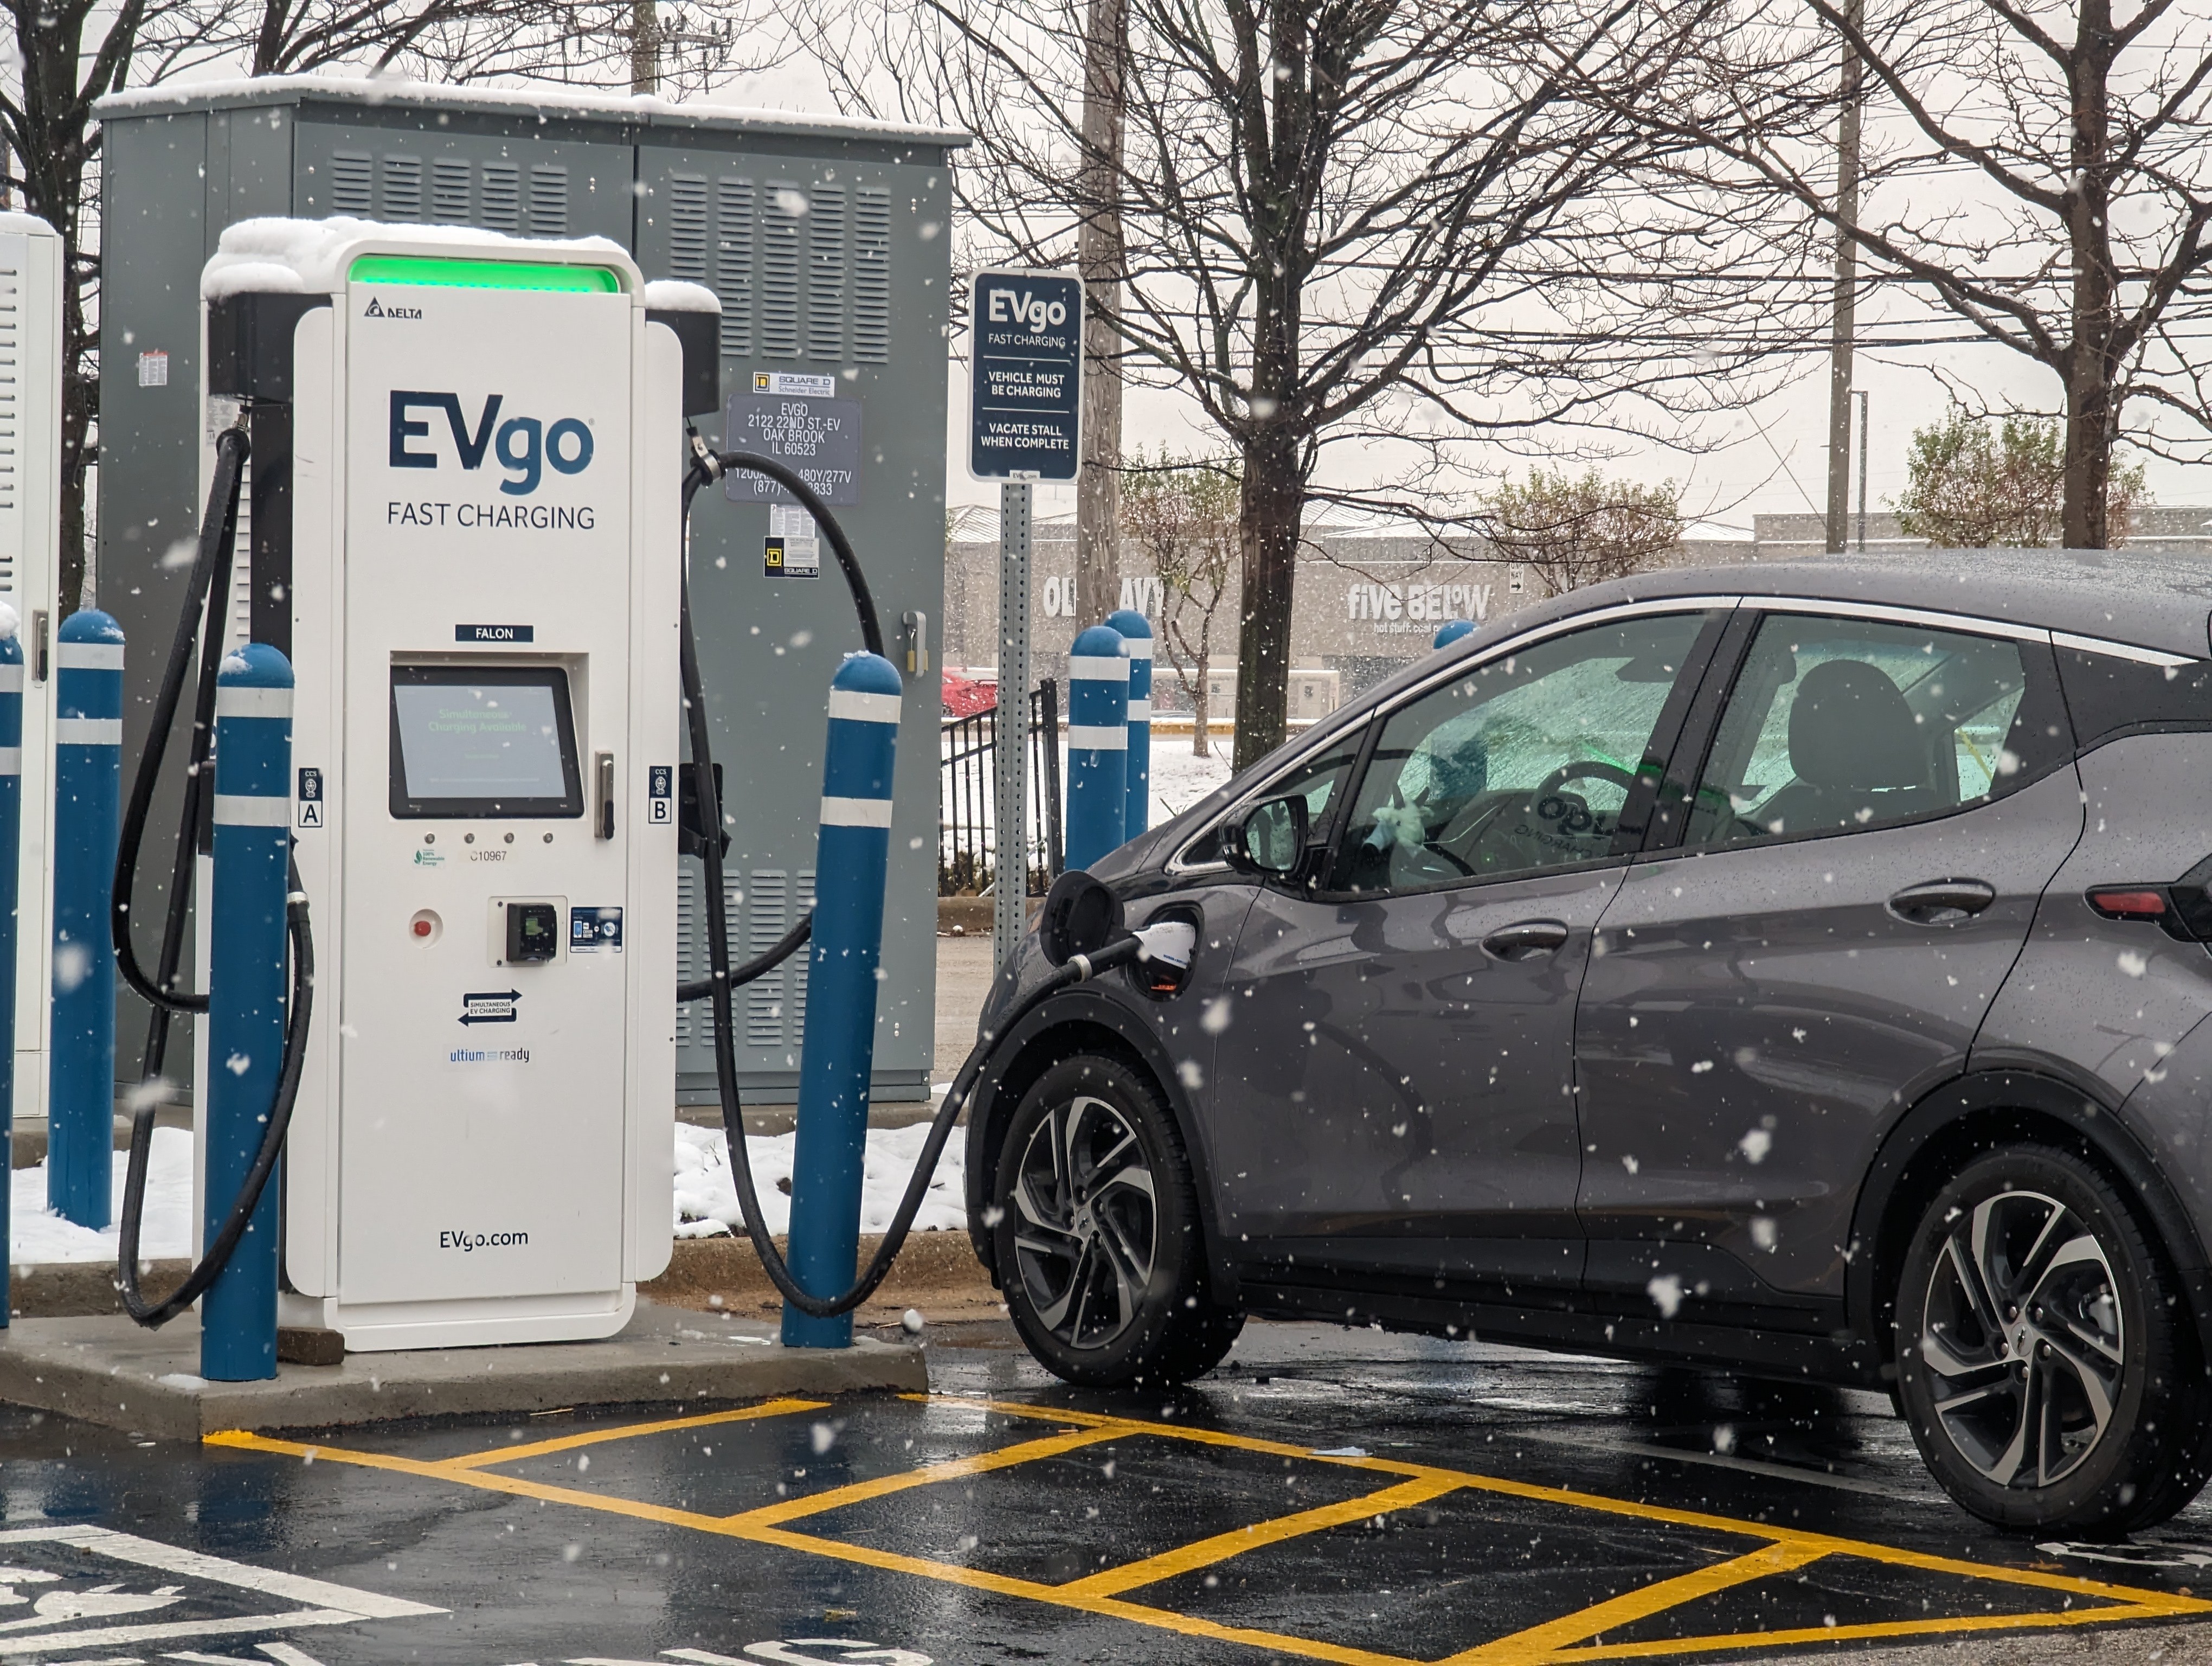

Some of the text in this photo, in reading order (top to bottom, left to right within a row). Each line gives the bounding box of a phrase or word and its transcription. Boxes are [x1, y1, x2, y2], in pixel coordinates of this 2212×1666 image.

[387, 307, 422, 319] DELTA
[989, 290, 1066, 333] EVgo
[989, 334, 1065, 347] FAST CHARGING
[779, 376, 818, 385] SQUARE
[989, 371, 1065, 385] VEHICLE MUST
[779, 386, 806, 394] Schneider
[992, 385, 1061, 398] BE CHARGING
[781, 403, 808, 415] EVGO
[748, 414, 773, 427] 2122
[776, 416, 804, 429] 22ND
[989, 423, 1062, 435] VACATE STALL
[389, 390, 594, 496] EVgo
[763, 429, 825, 444] OAK BROOK
[981, 436, 1069, 449] WHEN COMPLETE
[772, 443, 816, 456] IL 60523
[388, 502, 595, 529] FAST CHARGING
[1043, 576, 1076, 617] OL
[475, 628, 513, 639] FALON
[1374, 622, 1387, 633] hot
[428, 722, 527, 735] Charging Available
[303, 804, 318, 823] A
[655, 801, 666, 819] B
[451, 1047, 529, 1063] ultium ready
[440, 1231, 528, 1252] EVgo.com
